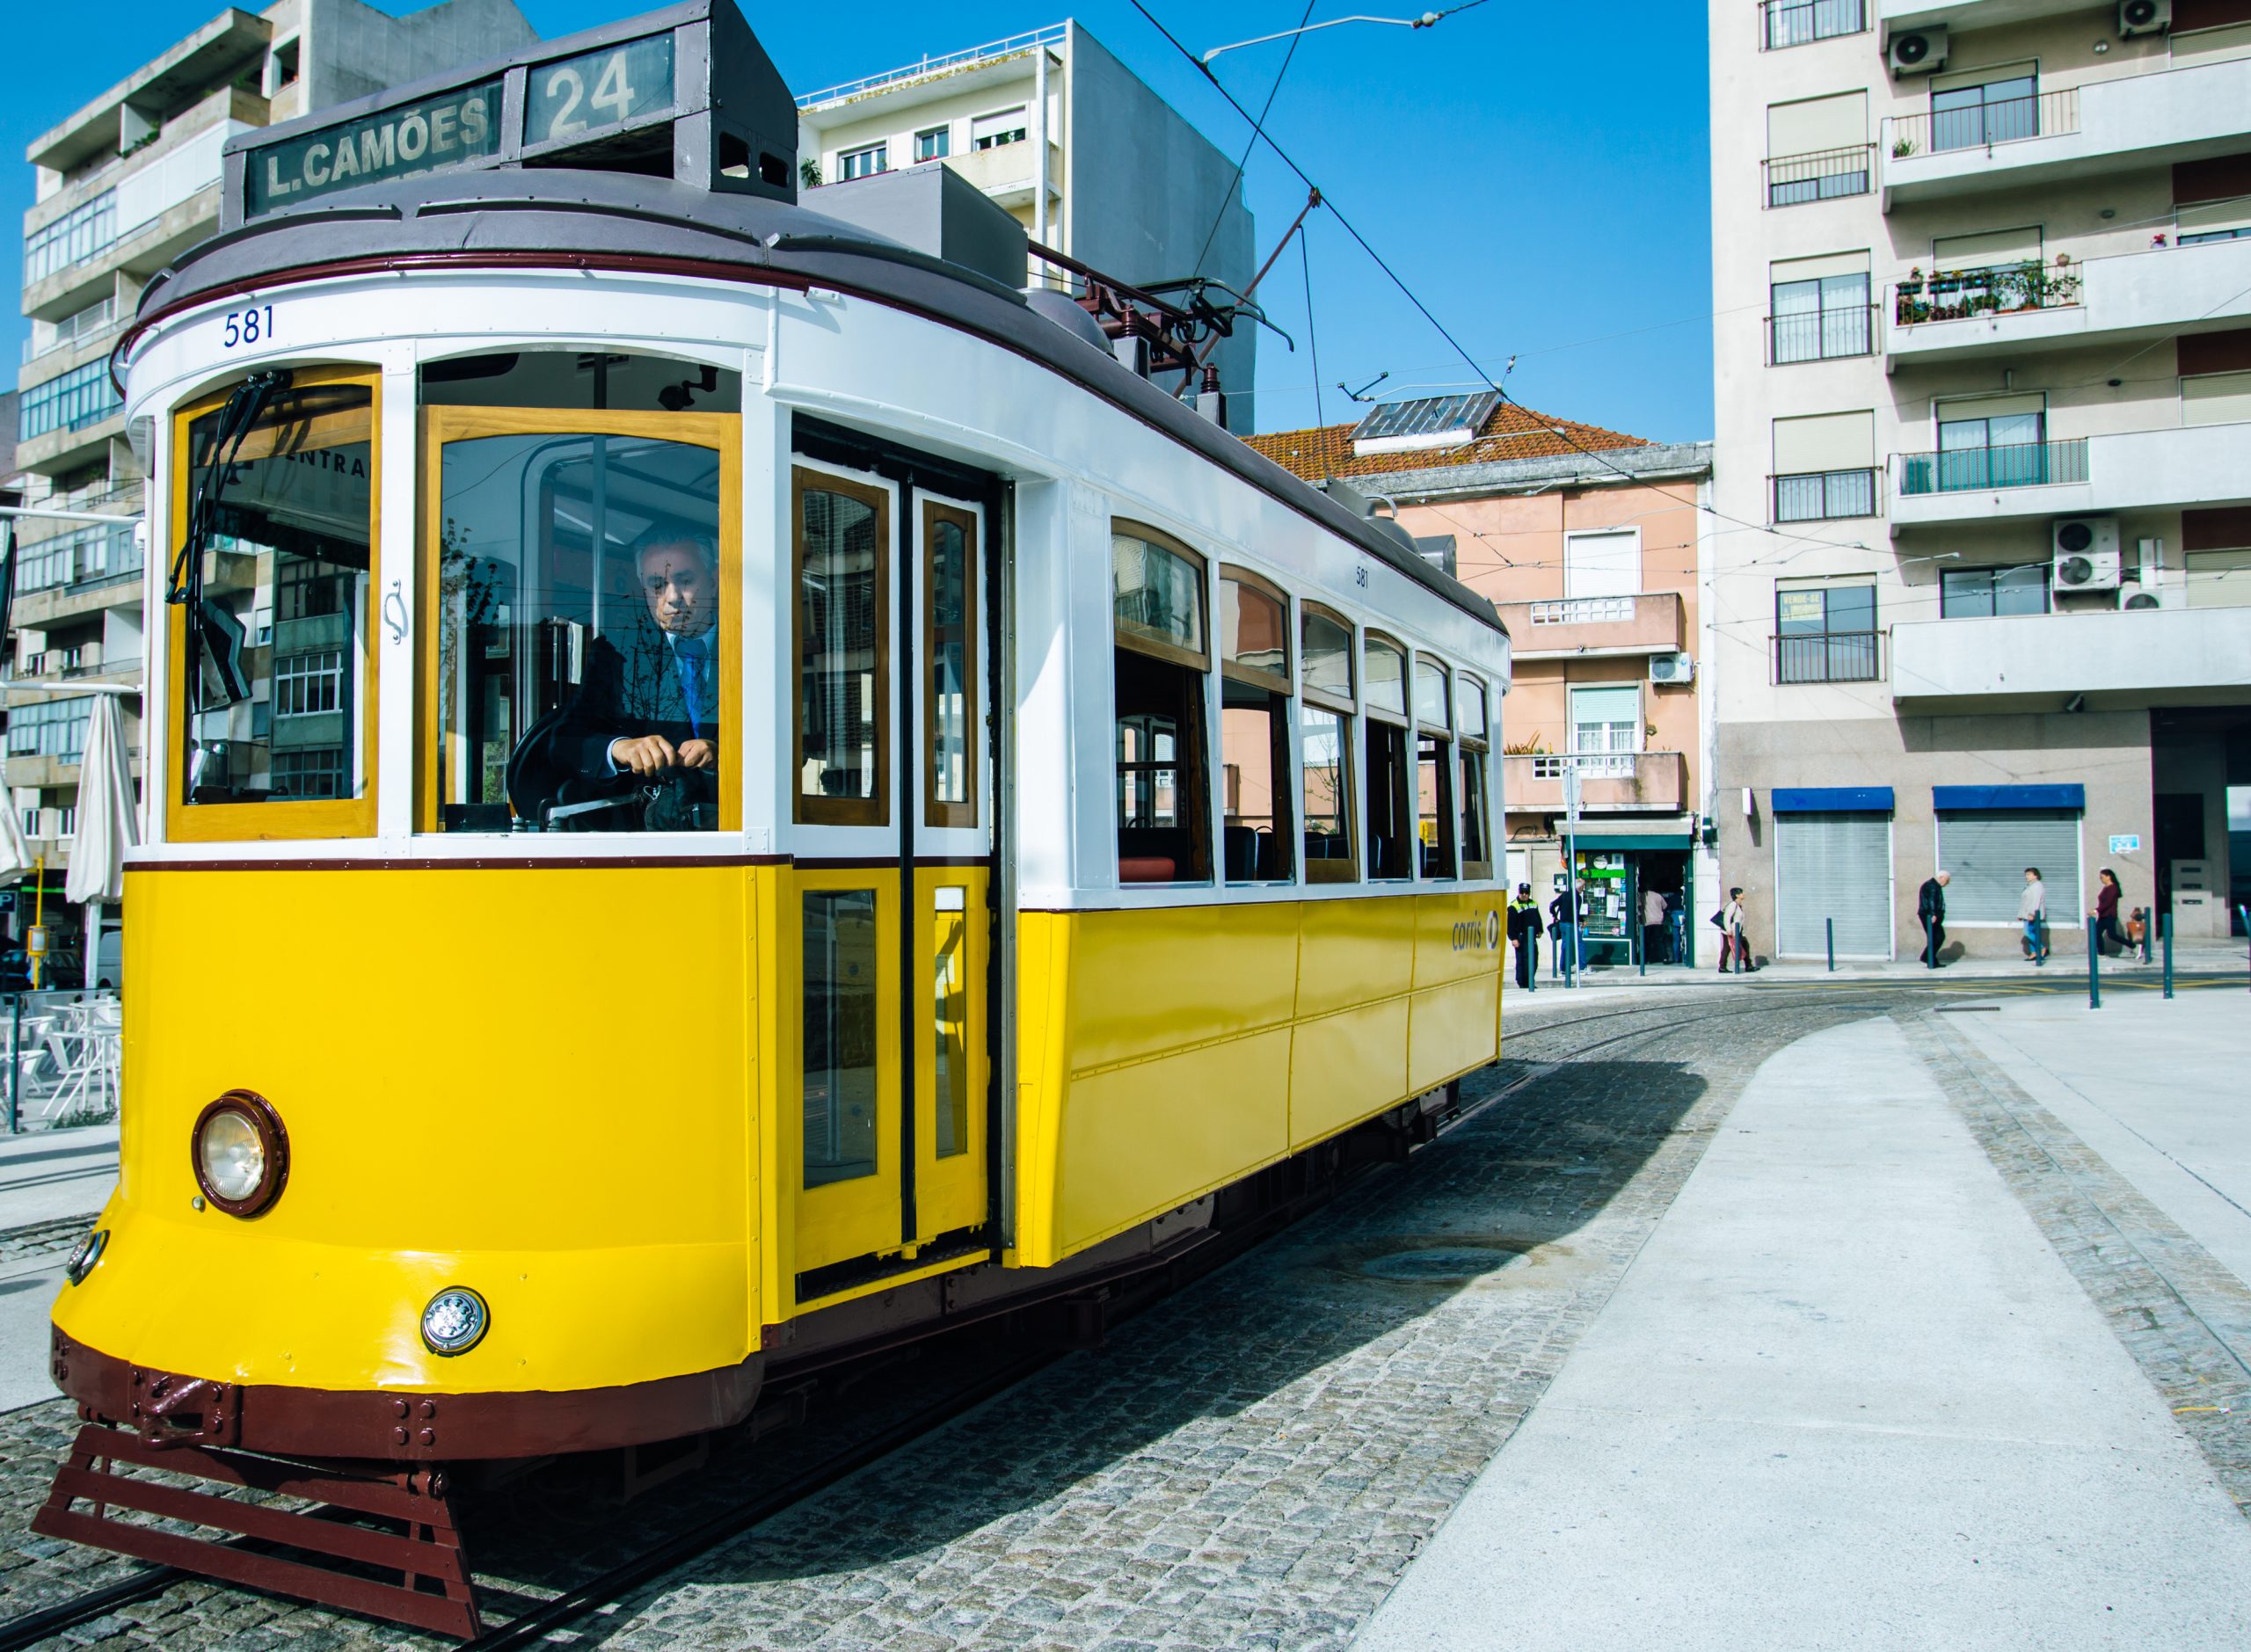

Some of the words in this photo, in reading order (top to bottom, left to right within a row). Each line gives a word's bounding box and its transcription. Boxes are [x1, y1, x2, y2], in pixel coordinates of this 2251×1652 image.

[546, 51, 635, 142] 24
[267, 98, 489, 198] L.CAMÕES
[224, 305, 273, 348] 581
[285, 448, 371, 479] NTRA
[1356, 565, 1368, 590] 581
[1452, 909, 1482, 951] carris
